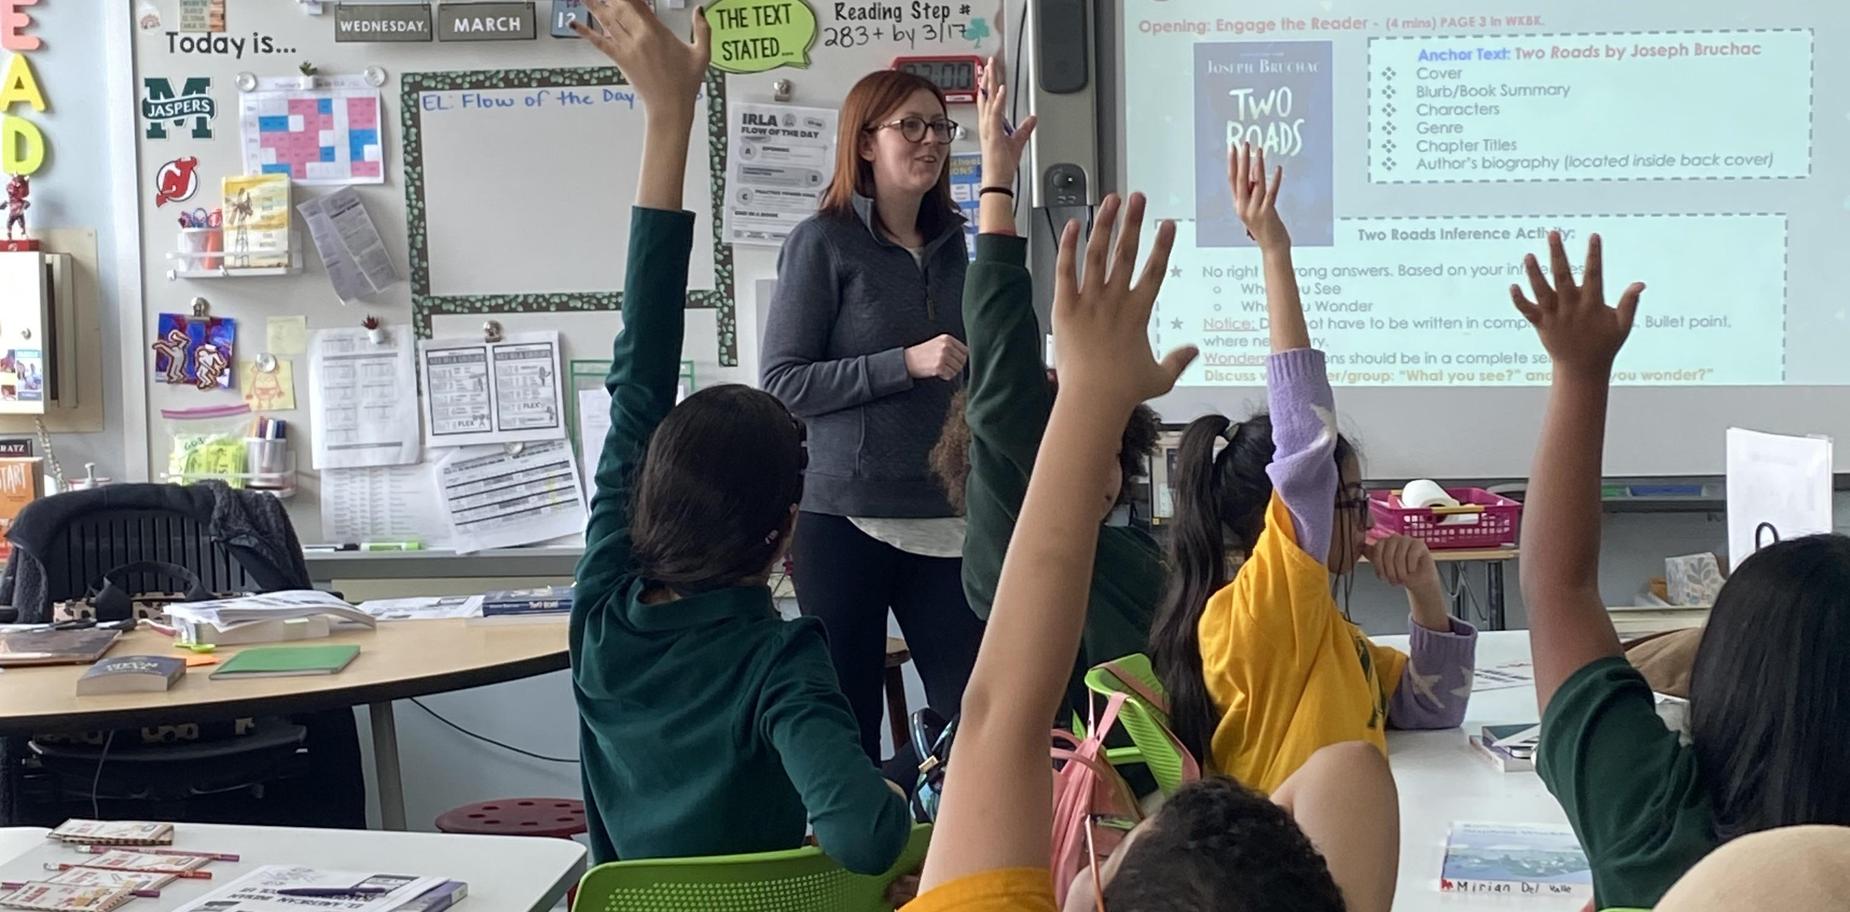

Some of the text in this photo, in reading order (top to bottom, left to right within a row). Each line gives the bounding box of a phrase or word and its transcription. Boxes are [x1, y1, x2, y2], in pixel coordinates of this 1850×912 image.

[716, 4, 792, 30] THE TEXT
[835, 1, 971, 23] Reading Step #
[454, 17, 521, 32] MARCH
[1139, 19, 1211, 36] Opening:
[1215, 19, 1276, 34] Engage
[1280, 17, 1306, 32] the
[1311, 17, 1368, 31] Reader
[1386, 18, 1399, 31] (4
[1402, 17, 1437, 31] mins)
[1440, 17, 1476, 28] PAGE
[1479, 17, 1487, 27] 3
[824, 22, 967, 49] 283+ by 3/17
[165, 31, 297, 59] Today is...
[1417, 42, 1762, 62] Anchor Text: Two Roads by Joseph Bruchac
[1416, 66, 1463, 80] Cover
[462, 93, 515, 108] Flow
[524, 90, 552, 107] of
[559, 91, 594, 105] the
[602, 89, 636, 109] Day
[1416, 83, 1571, 99] Blurb/Book Summary
[147, 99, 211, 118] JASPERS
[1228, 85, 1293, 121] TWO
[1416, 102, 1501, 117] Characters
[742, 113, 779, 127] IRLA
[1416, 120, 1464, 135] Genre
[741, 126, 820, 139] FLOW OF THE DAY
[1226, 118, 1305, 158] ROADS
[1416, 138, 1518, 155] Chapter Titles
[1481, 156, 1560, 173] biography
[1563, 153, 1629, 171] (located
[1632, 152, 1676, 168] inside
[1679, 152, 1721, 167] back
[1723, 152, 1775, 169] cover)
[1358, 228, 1387, 241] Two
[1391, 228, 1437, 241] Roads
[1440, 227, 1511, 241] Inference
[1202, 266, 1224, 278] No
[1226, 265, 1259, 281] right
[1294, 266, 1328, 280] rong
[1331, 265, 1394, 278] answers.
[1398, 263, 1444, 277] Based
[1447, 265, 1468, 277] on
[1470, 265, 1503, 280] your
[1314, 283, 1342, 295] See
[1315, 300, 1374, 313] Wonder
[1203, 317, 1255, 330] Notice:
[1309, 318, 1324, 330] ot
[1327, 317, 1365, 330] have
[1370, 317, 1387, 330] to
[1388, 317, 1409, 330] be
[1412, 317, 1463, 330] written
[1466, 317, 1479, 329] in
[1645, 315, 1685, 329] Bullet
[1203, 335, 1249, 347] where
[1349, 352, 1396, 365] should
[1400, 352, 1421, 365] be
[1424, 352, 1437, 364] in
[1440, 354, 1453, 364] a
[1455, 352, 1529, 367] complete
[1204, 369, 1258, 382] Discuss
[1448, 371, 1476, 384] you
[1609, 371, 1637, 384] you
[0, 462, 26, 494] TART
[1457, 881, 1511, 893] Mirian
[1521, 881, 1540, 894] Del
